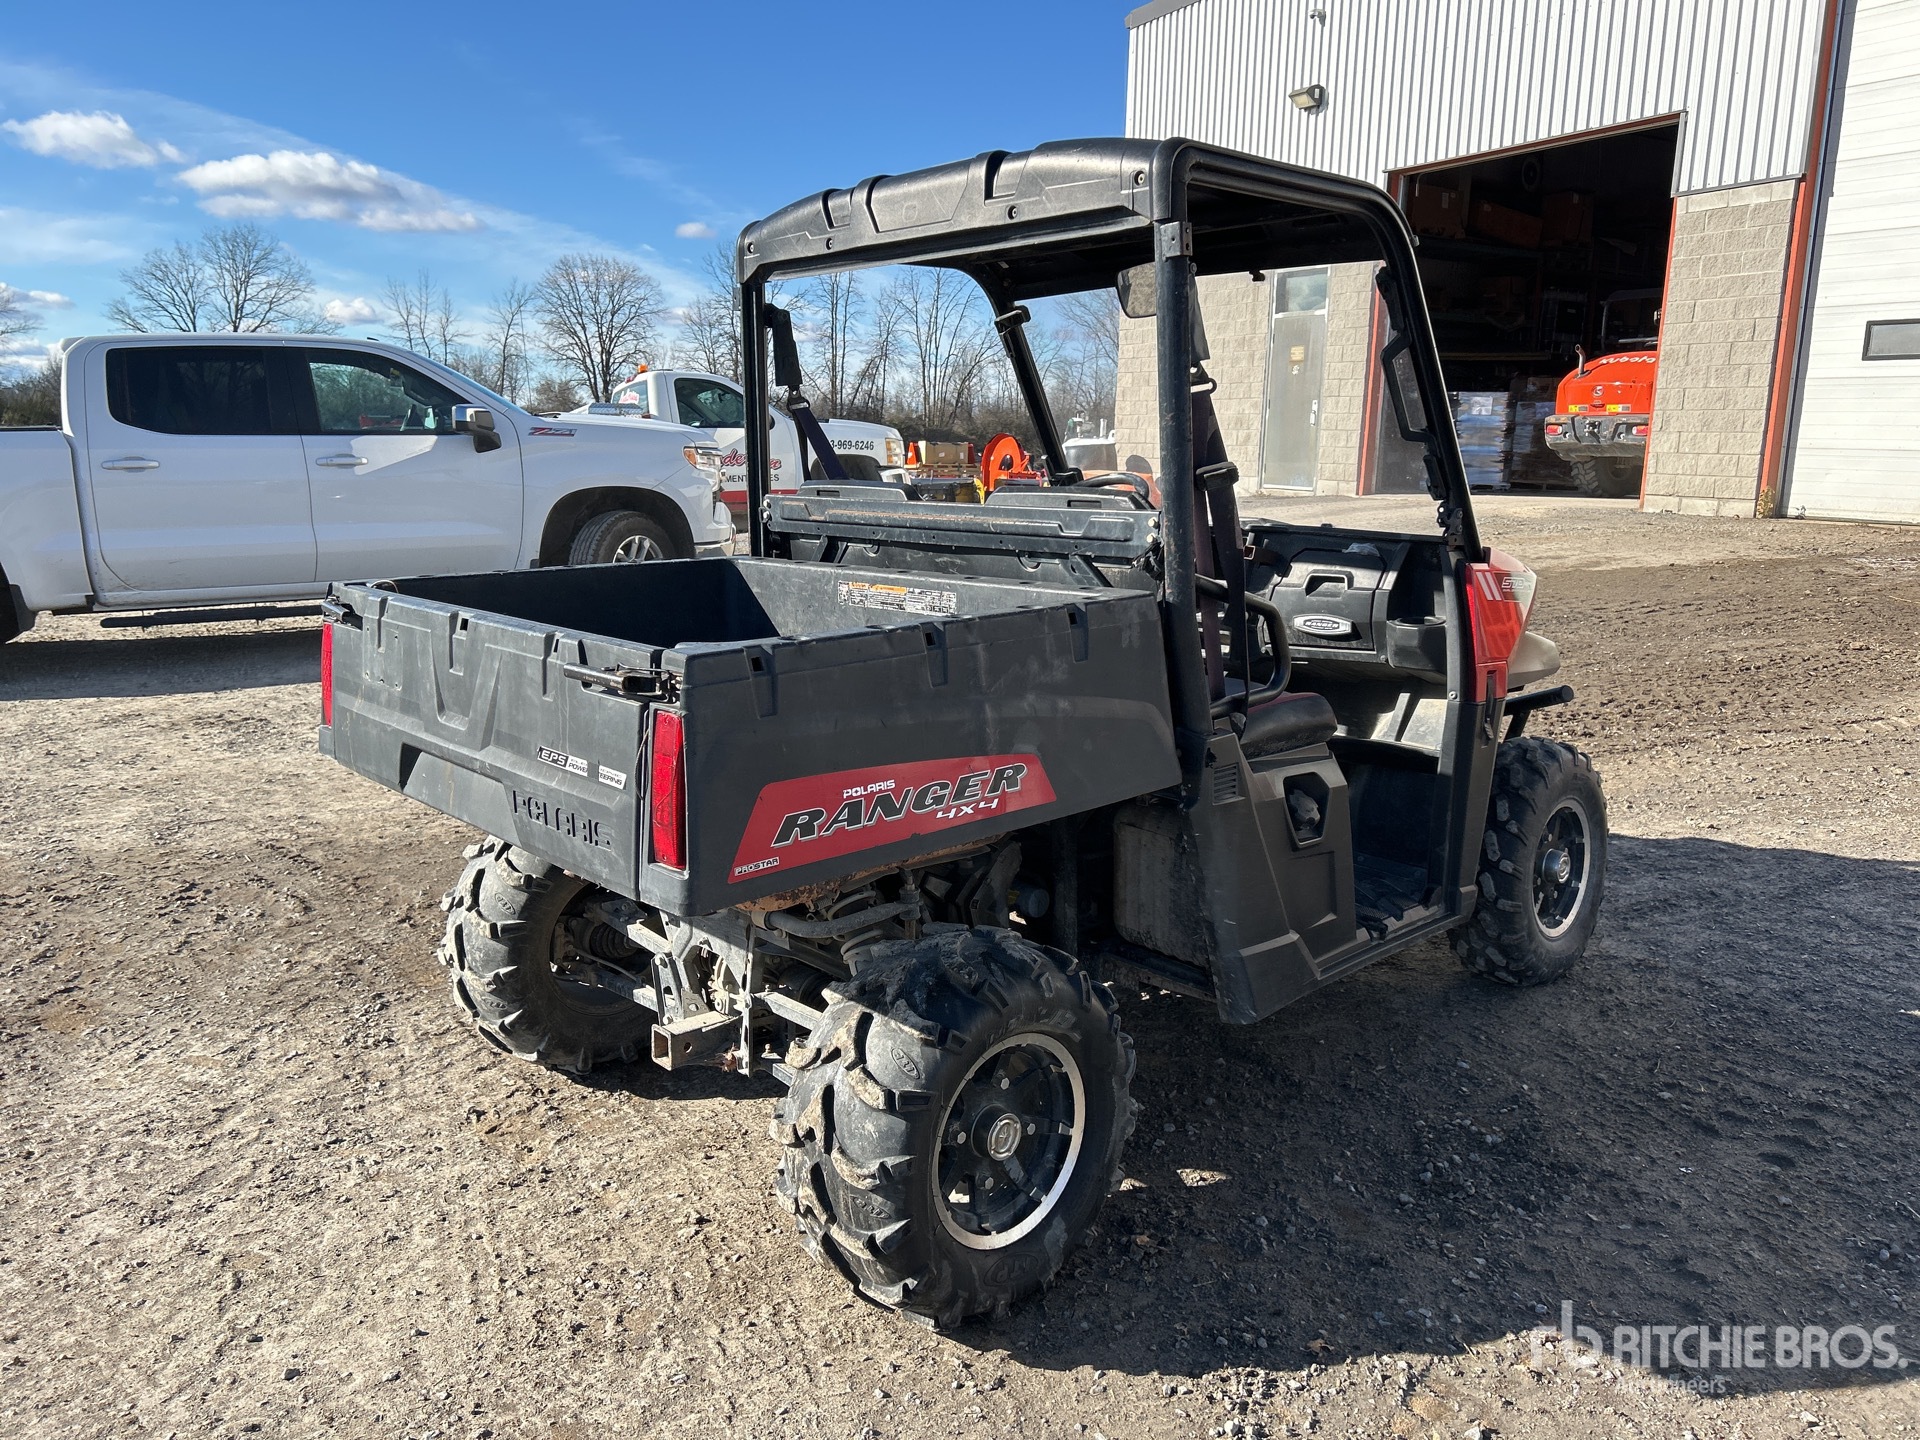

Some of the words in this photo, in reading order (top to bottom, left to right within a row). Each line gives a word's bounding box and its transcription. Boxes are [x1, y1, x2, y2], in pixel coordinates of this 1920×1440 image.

[829, 439, 875, 451] 3-969-6246
[541, 749, 567, 766] EPS
[568, 762, 588, 774] POWE
[599, 772, 623, 786] EERING
[843, 779, 896, 799] POLARIS
[770, 762, 1028, 849] RANGER
[512, 790, 613, 851] POLARIS
[735, 857, 779, 876] PROSTAR
